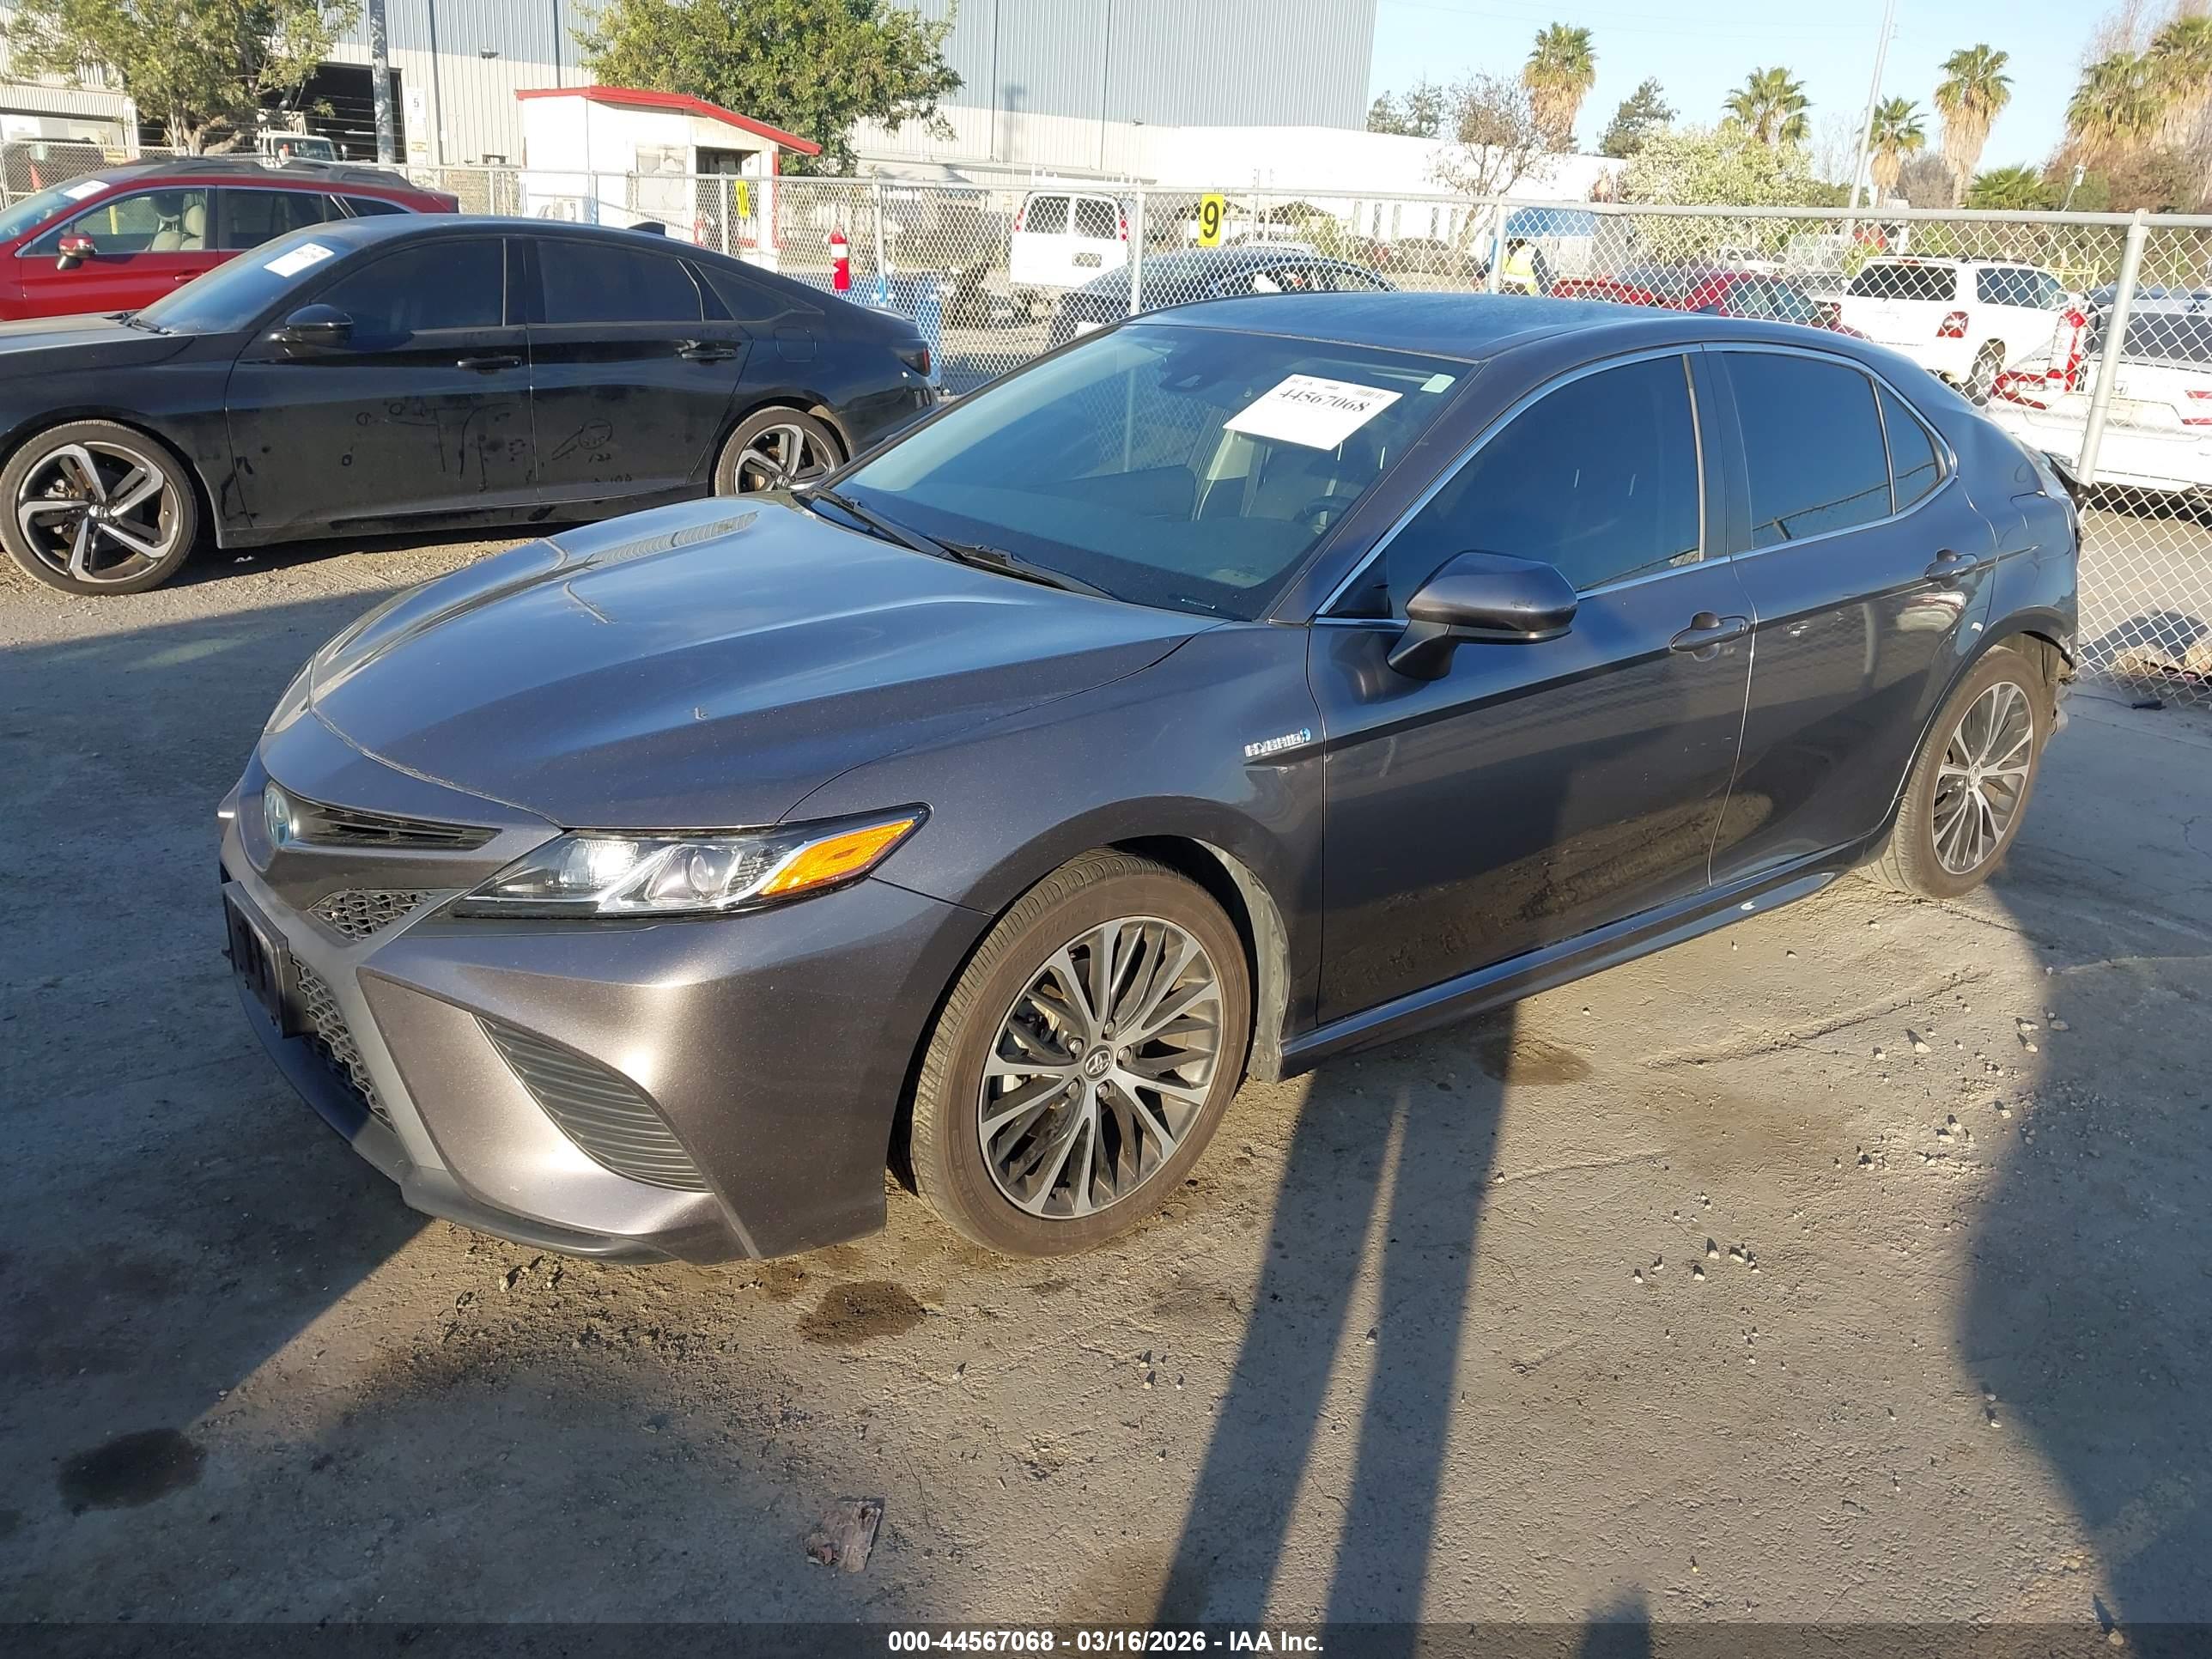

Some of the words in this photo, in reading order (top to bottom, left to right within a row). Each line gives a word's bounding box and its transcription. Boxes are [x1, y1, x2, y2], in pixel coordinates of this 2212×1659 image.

[413, 97, 420, 108] 5
[738, 185, 748, 212] 10
[1202, 200, 1220, 240] 9
[1278, 387, 1370, 413] 44567068
[1244, 733, 1303, 757] HYBRID
